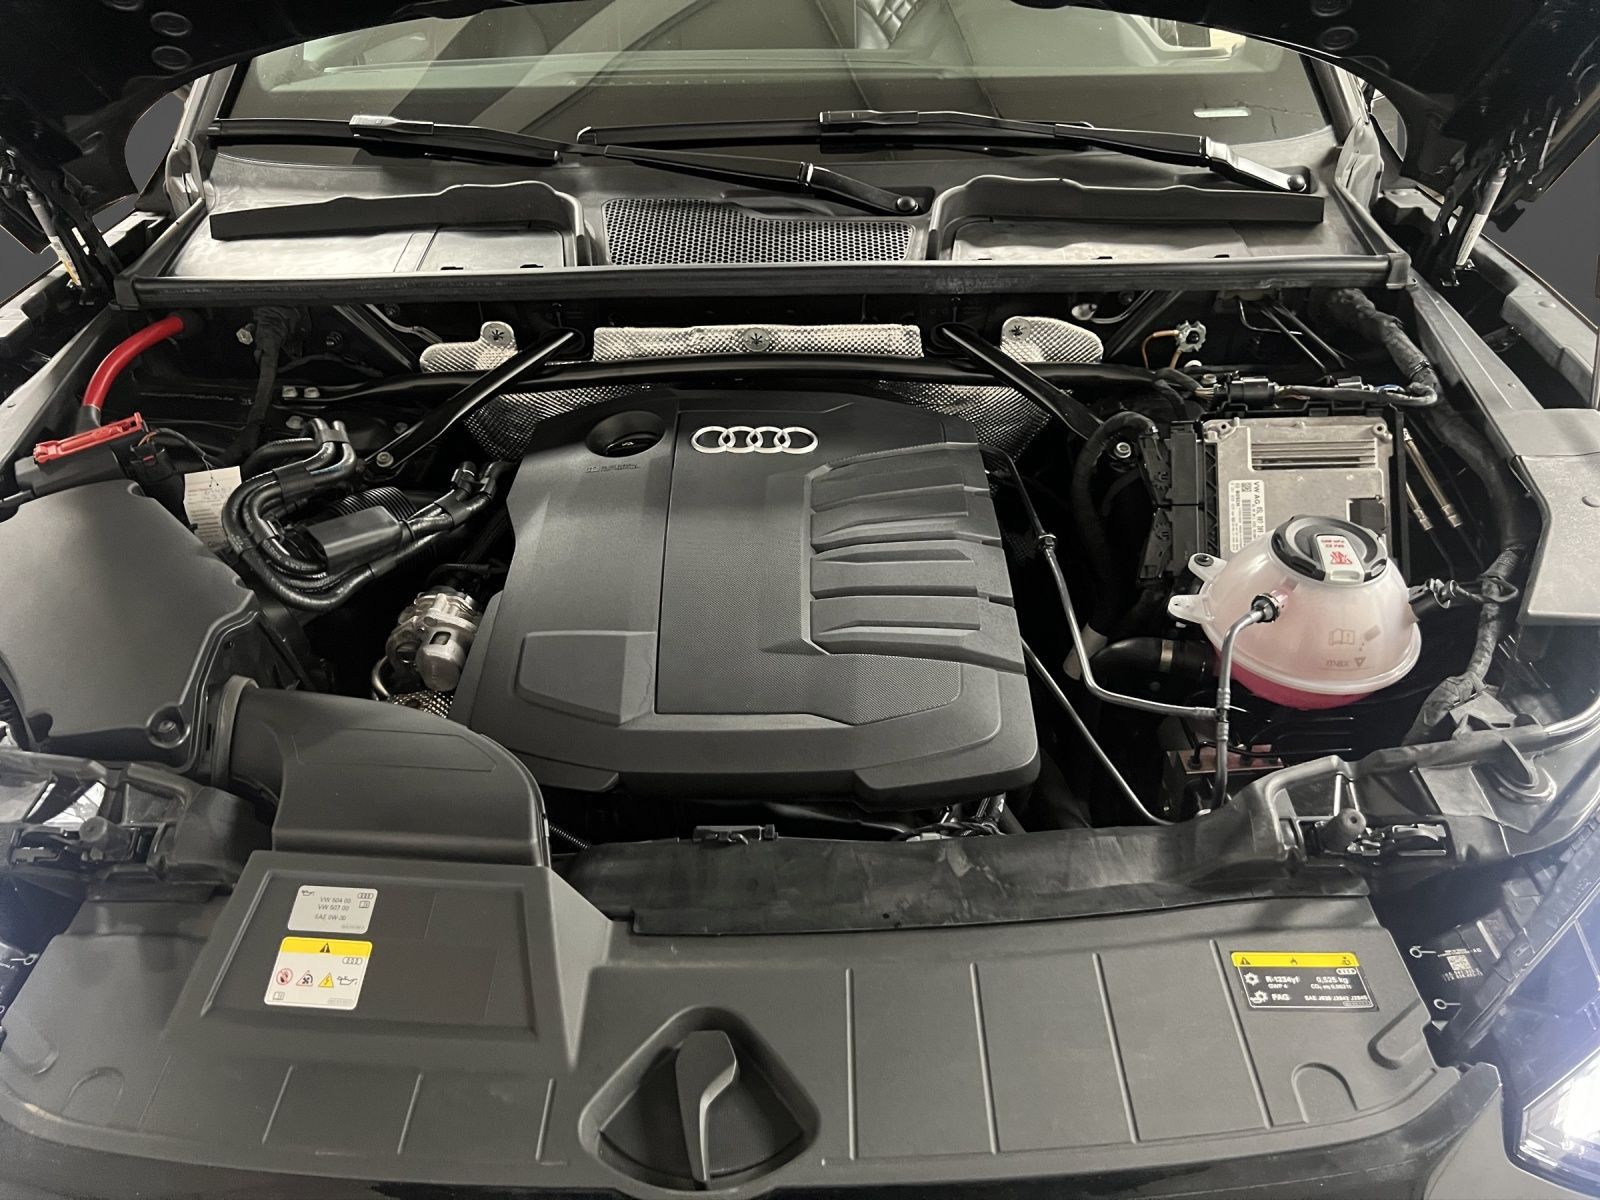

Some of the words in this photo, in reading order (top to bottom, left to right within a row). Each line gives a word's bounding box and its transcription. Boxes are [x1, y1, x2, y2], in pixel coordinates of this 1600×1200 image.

[1254, 481, 1260, 493] VW
[1254, 494, 1260, 505] AG
[1326, 657, 1349, 667] max
[1338, 976, 1349, 984] kg
